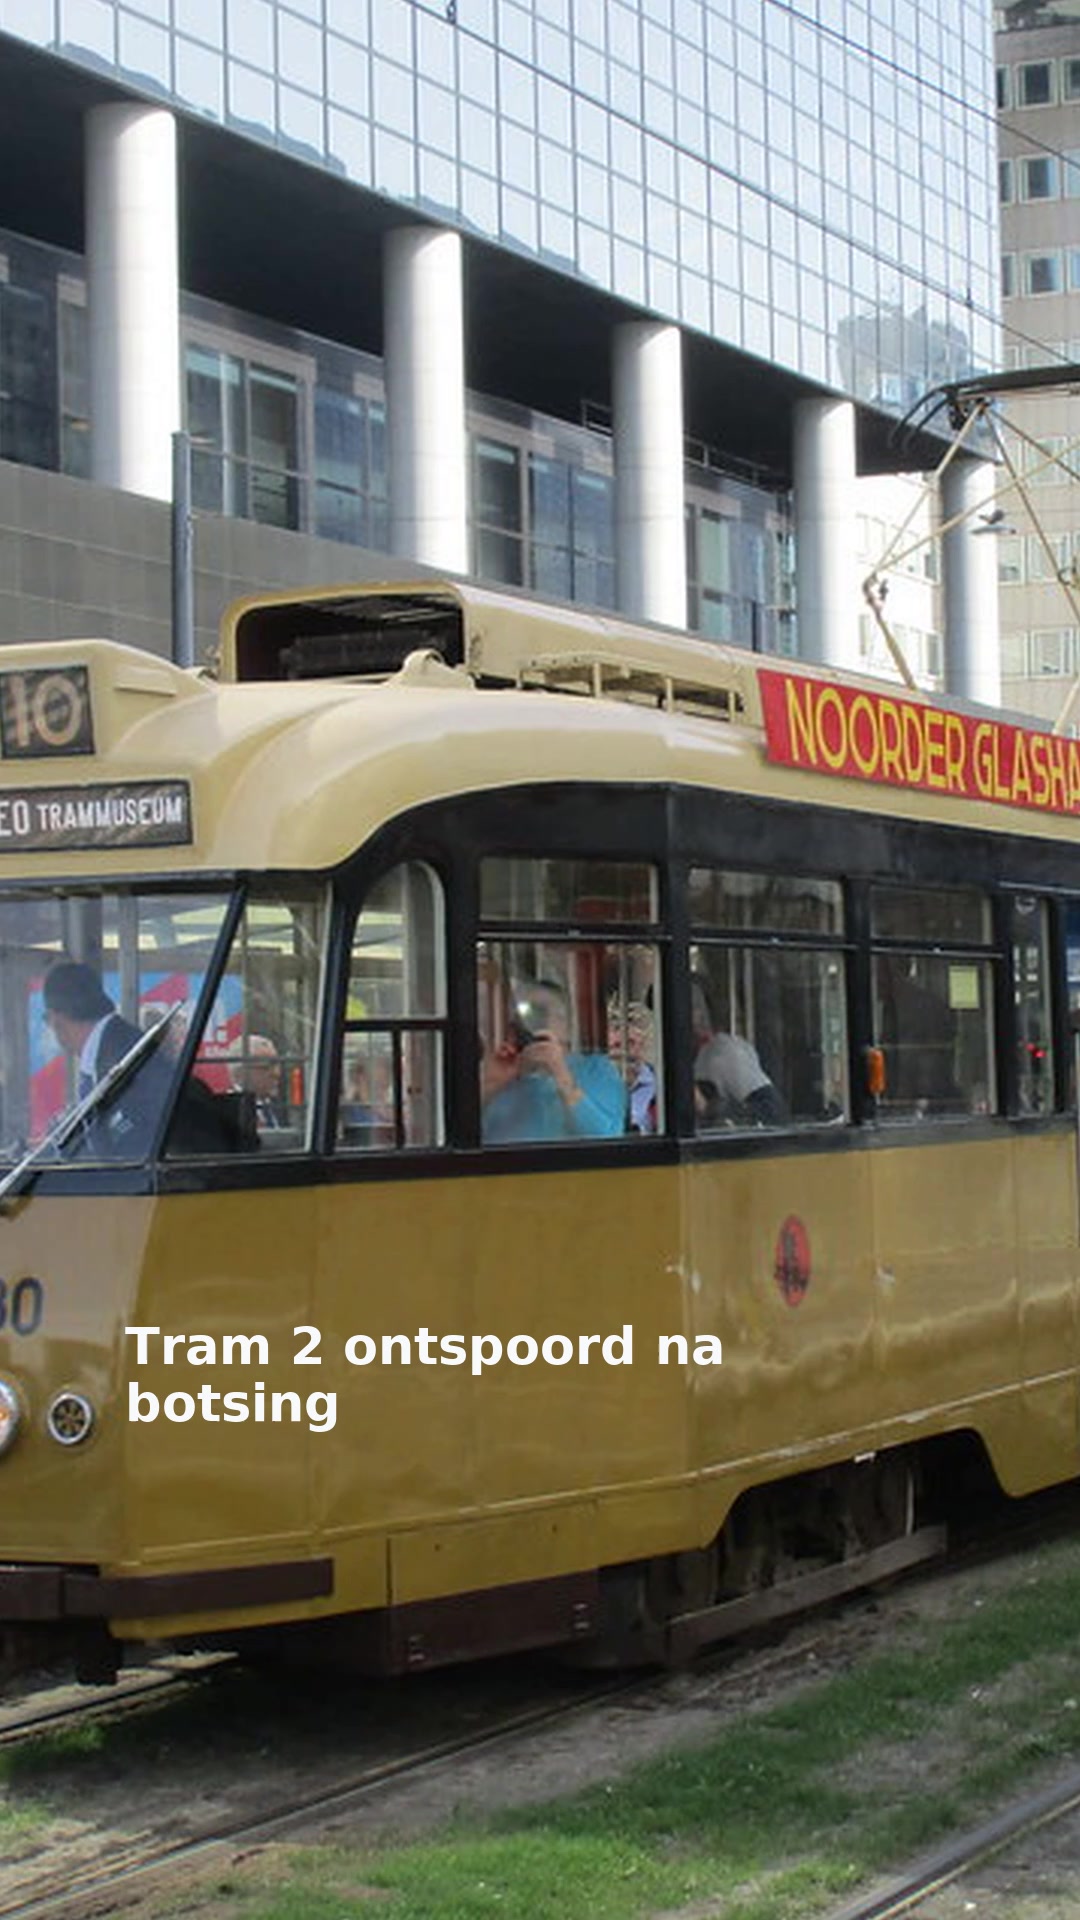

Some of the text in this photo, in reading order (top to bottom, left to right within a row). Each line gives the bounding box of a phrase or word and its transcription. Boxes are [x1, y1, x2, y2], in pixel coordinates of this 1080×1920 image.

[9, 674, 81, 747] 10
[785, 678, 967, 792] NOORDER
[36, 796, 183, 831] TRAMMUSEUM
